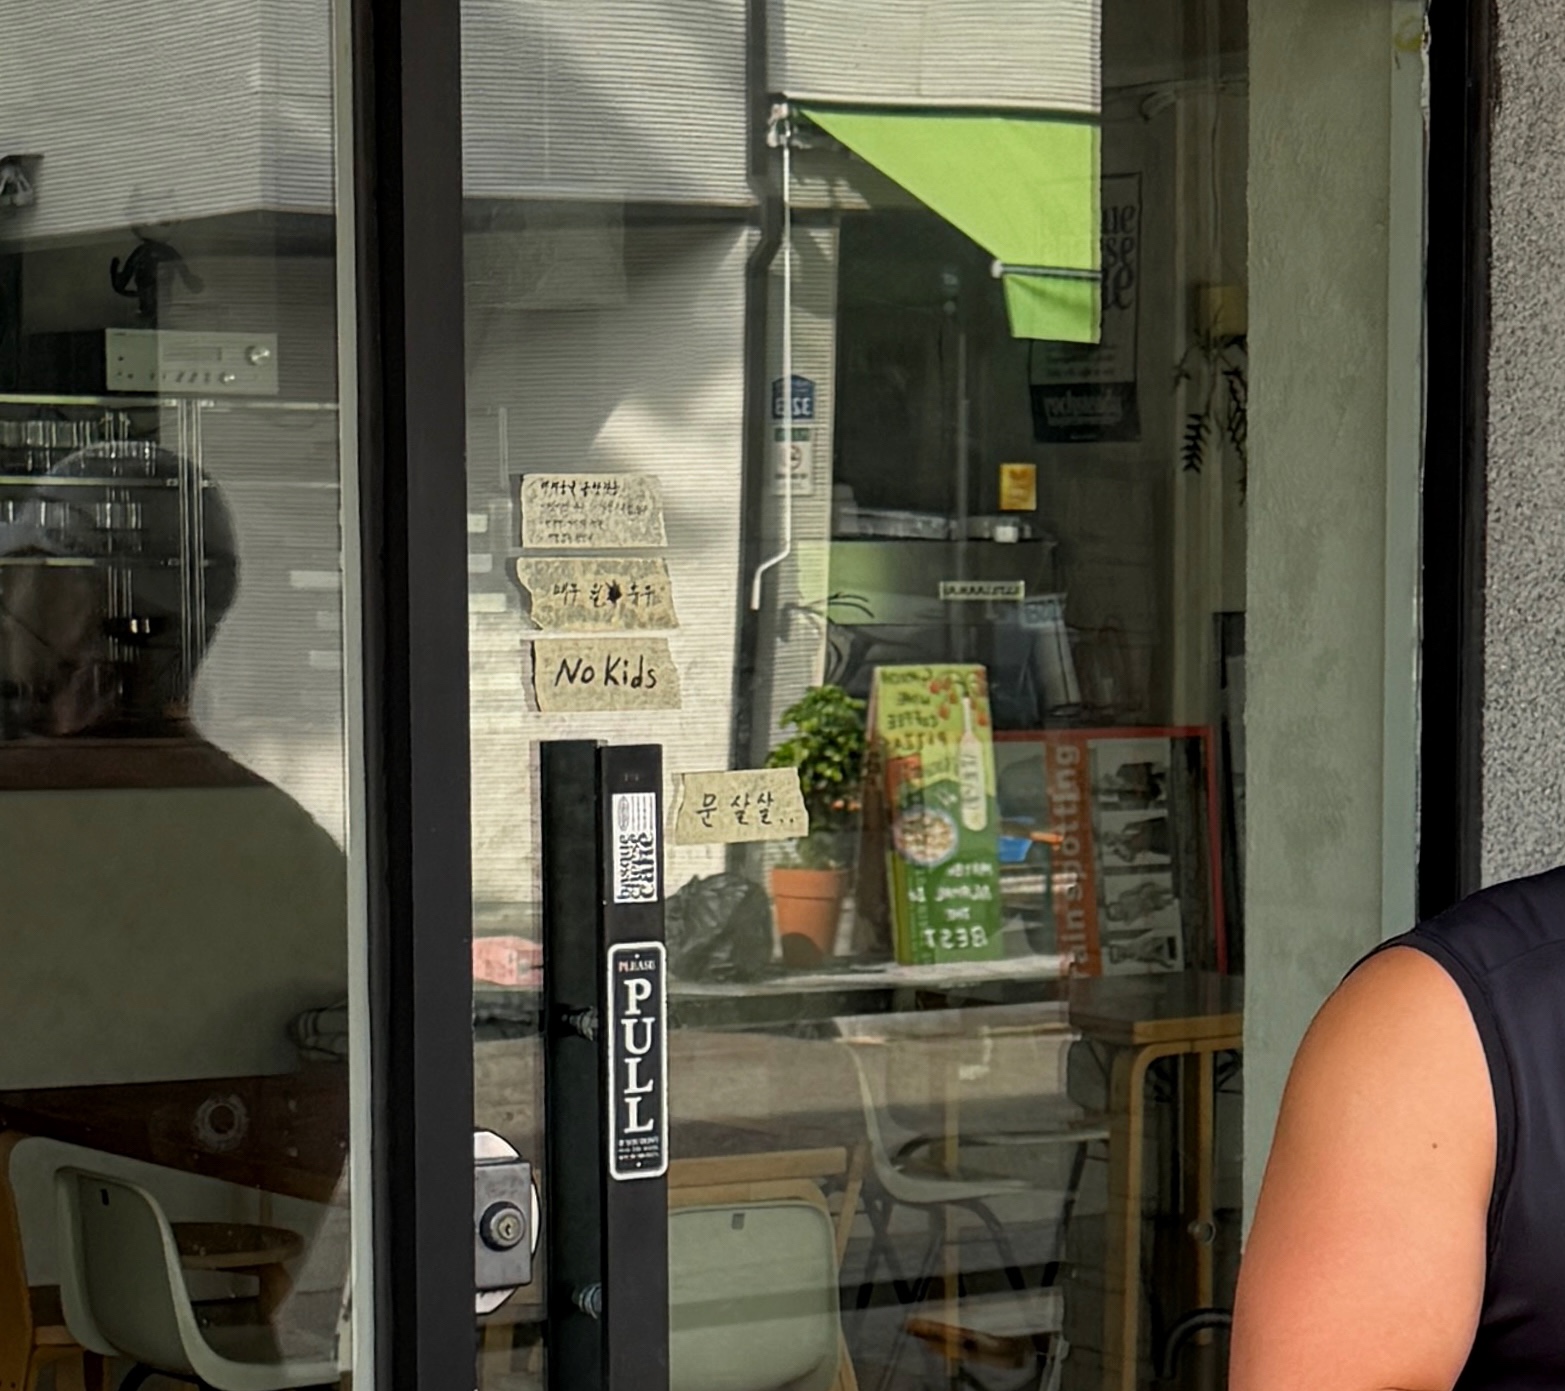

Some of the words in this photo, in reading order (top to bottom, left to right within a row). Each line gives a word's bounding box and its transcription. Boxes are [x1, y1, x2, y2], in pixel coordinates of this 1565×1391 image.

[554, 656, 595, 687] No
[603, 655, 657, 689] Kids
[695, 793, 717, 827] 문
[621, 977, 656, 1134] PULL
